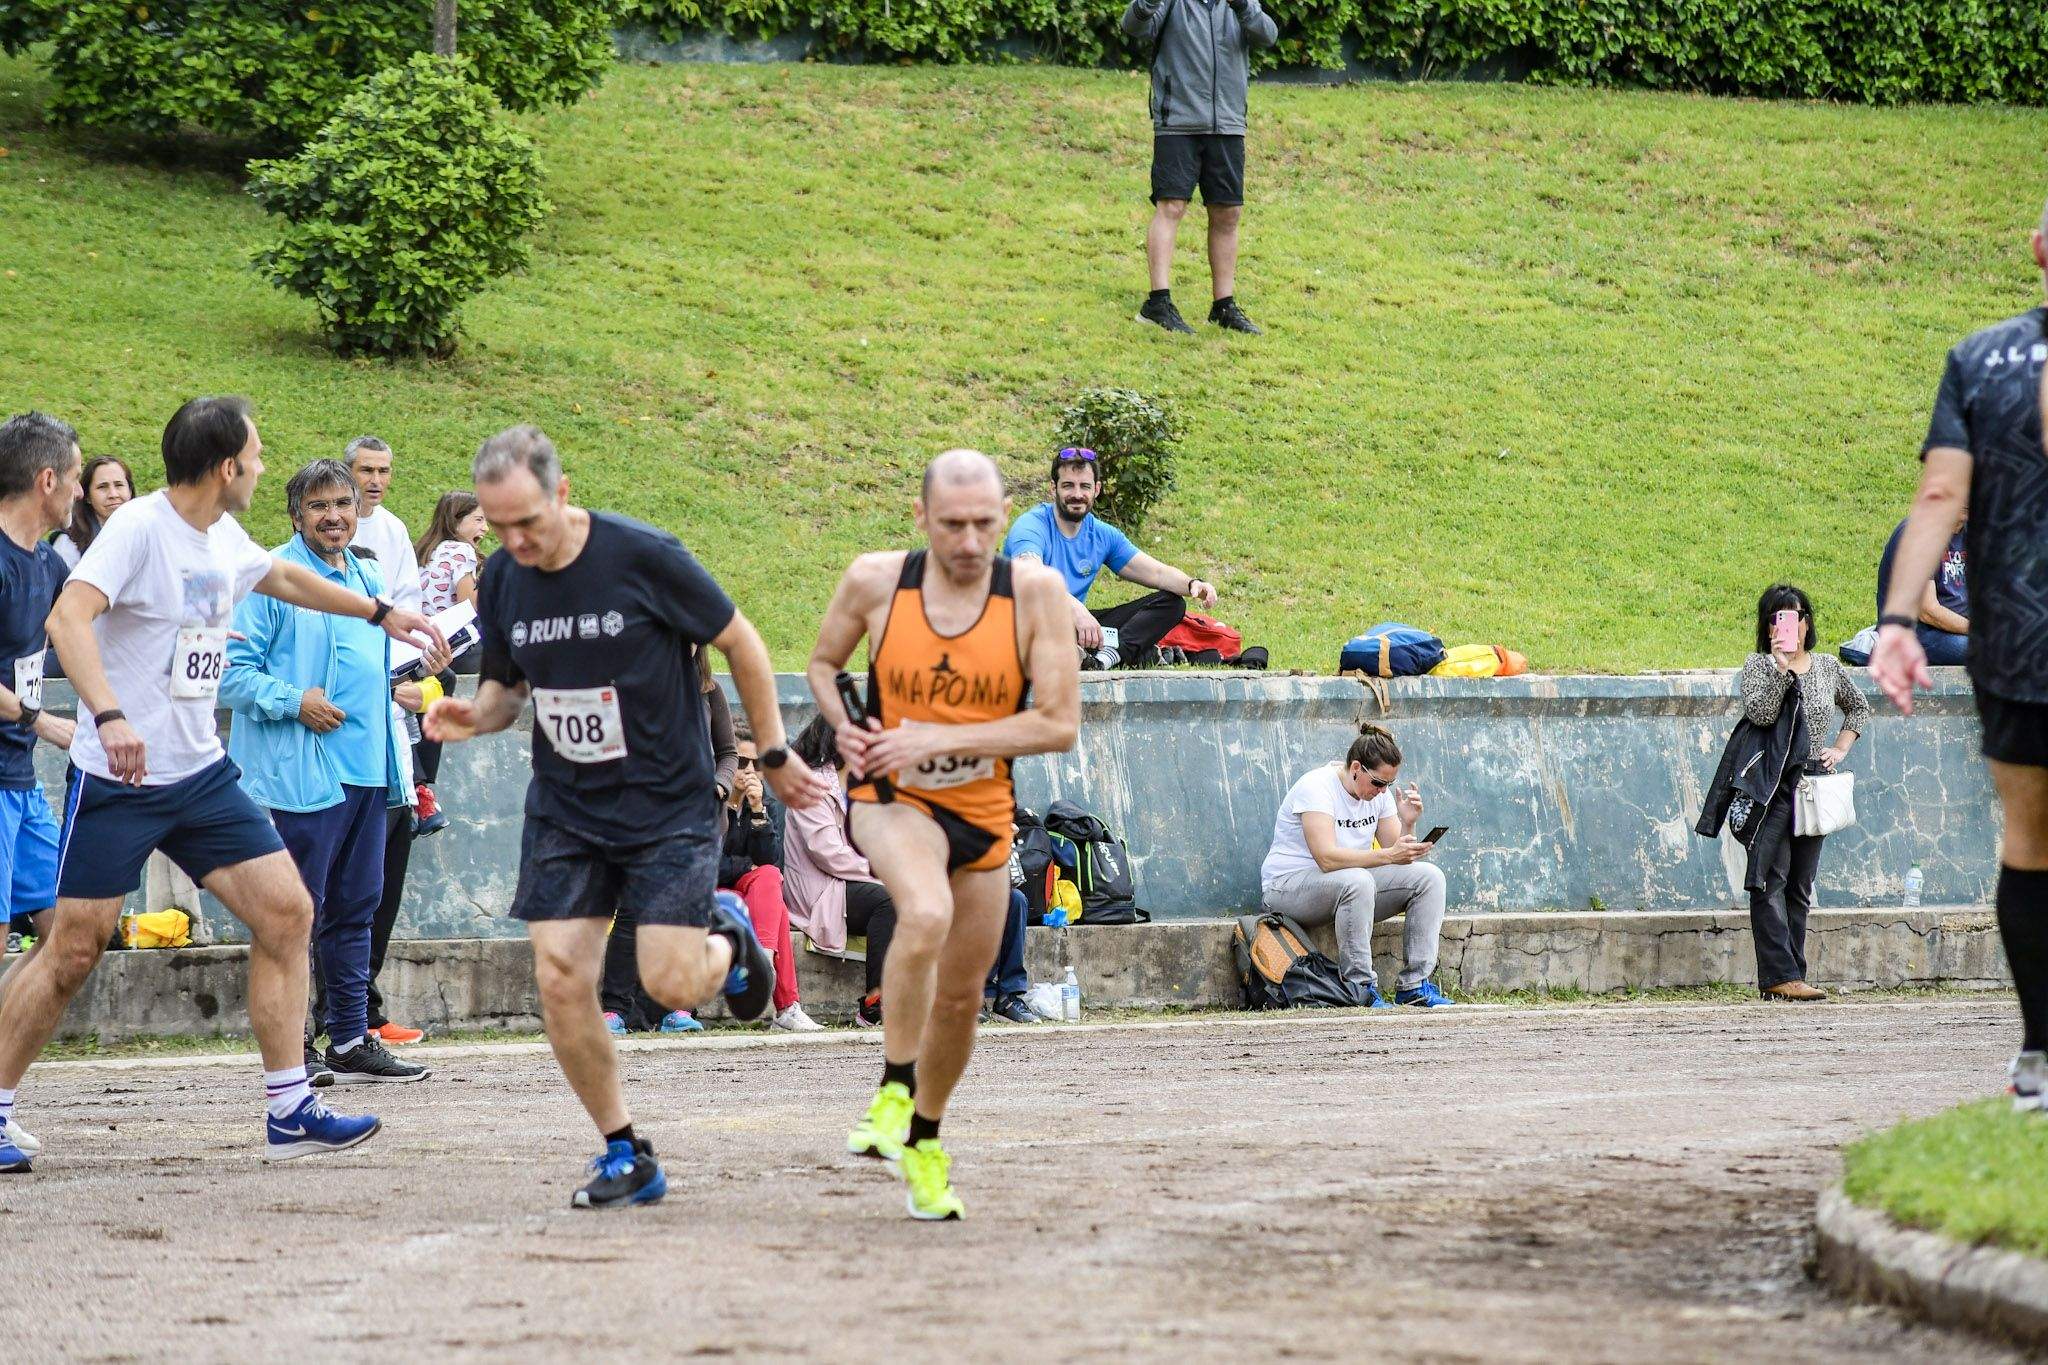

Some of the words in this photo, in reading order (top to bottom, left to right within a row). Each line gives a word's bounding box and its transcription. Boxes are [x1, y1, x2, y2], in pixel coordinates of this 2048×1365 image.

[529, 616, 574, 644] RUN
[186, 651, 221, 680] 828
[888, 666, 1008, 706] MAPOMA
[548, 714, 604, 744] 708
